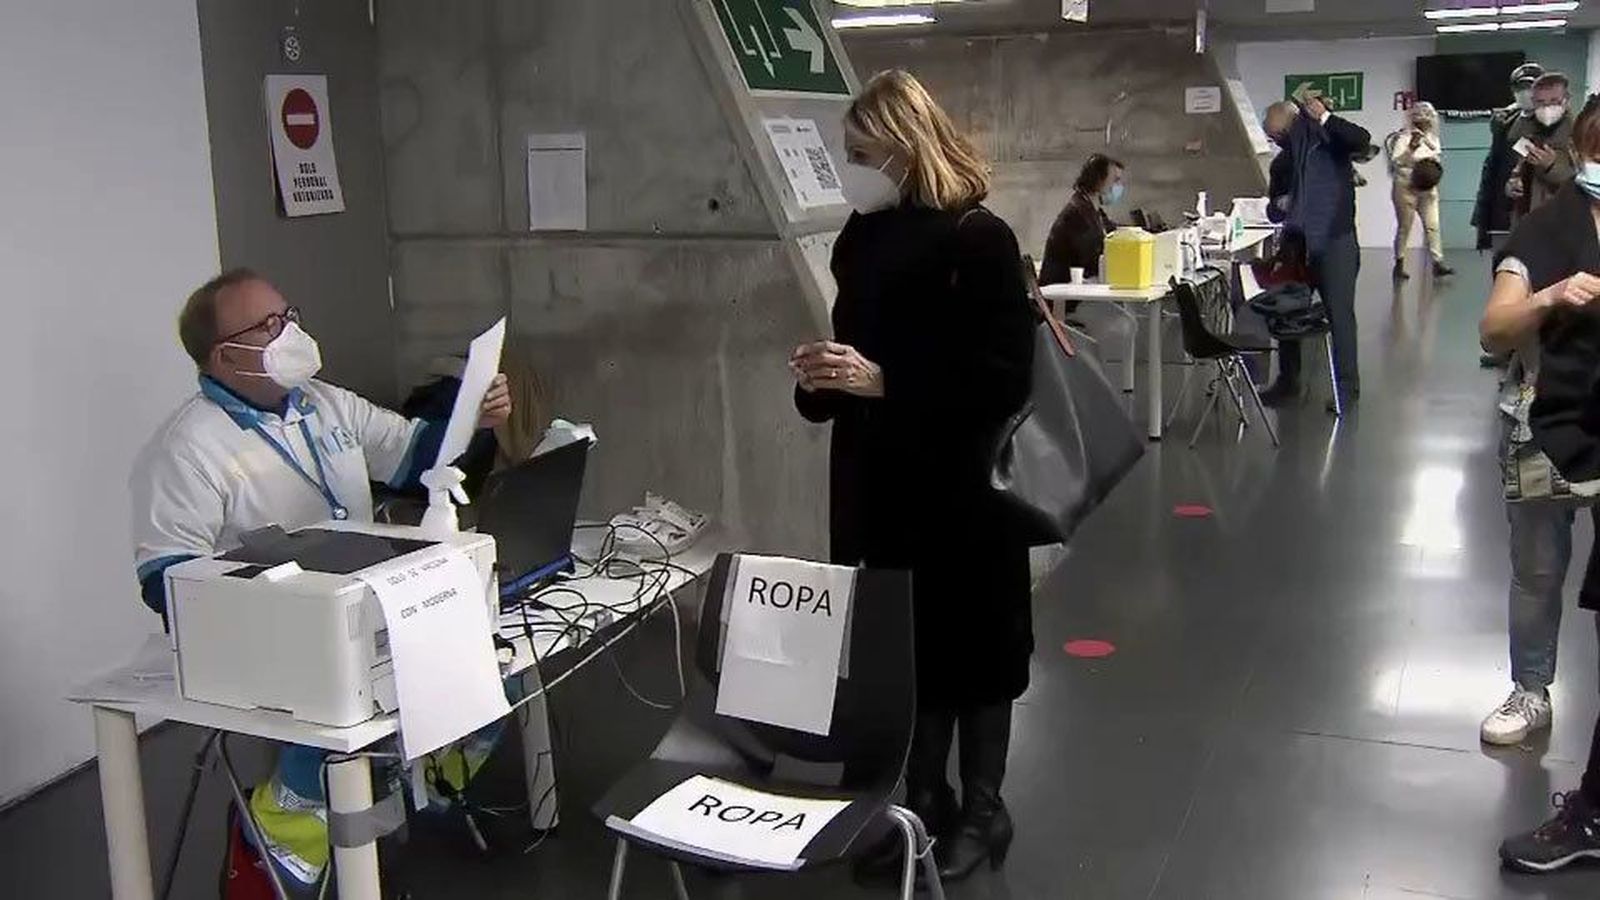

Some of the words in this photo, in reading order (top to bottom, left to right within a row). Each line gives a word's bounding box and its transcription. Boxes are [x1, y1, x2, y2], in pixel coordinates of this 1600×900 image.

[299, 162, 316, 174] SOLO
[293, 176, 327, 188] PERSONAL
[292, 189, 334, 203] AUTORIZADO
[400, 605, 418, 619] CON
[422, 587, 457, 608] MODERNA
[748, 576, 831, 617] ROPA
[687, 794, 806, 831] ROPA
